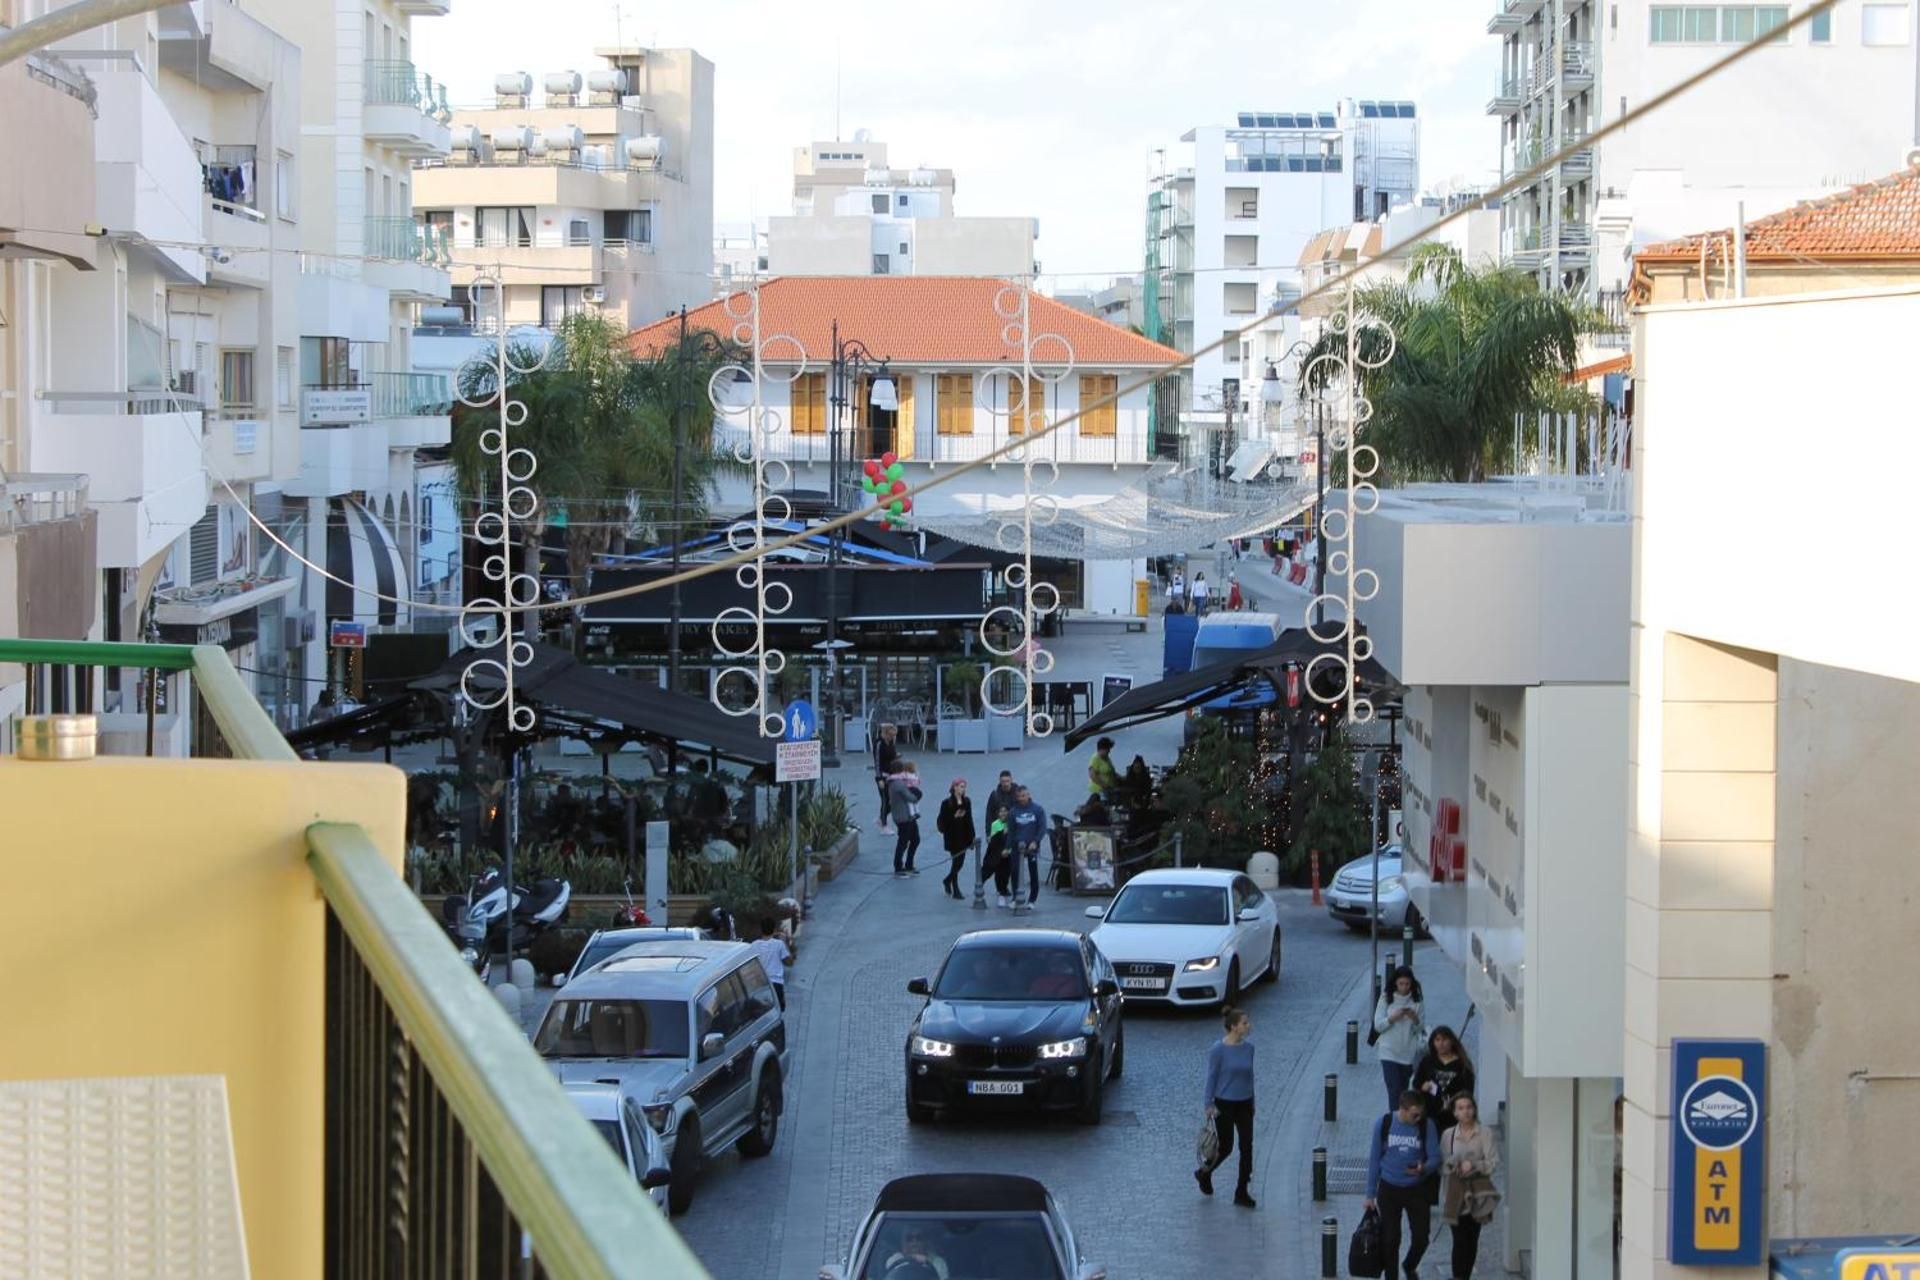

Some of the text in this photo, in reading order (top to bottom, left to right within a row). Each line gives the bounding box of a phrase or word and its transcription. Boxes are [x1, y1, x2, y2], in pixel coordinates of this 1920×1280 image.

[975, 1082, 1019, 1093] NBA 001
[1704, 1160, 1730, 1225] ATM
